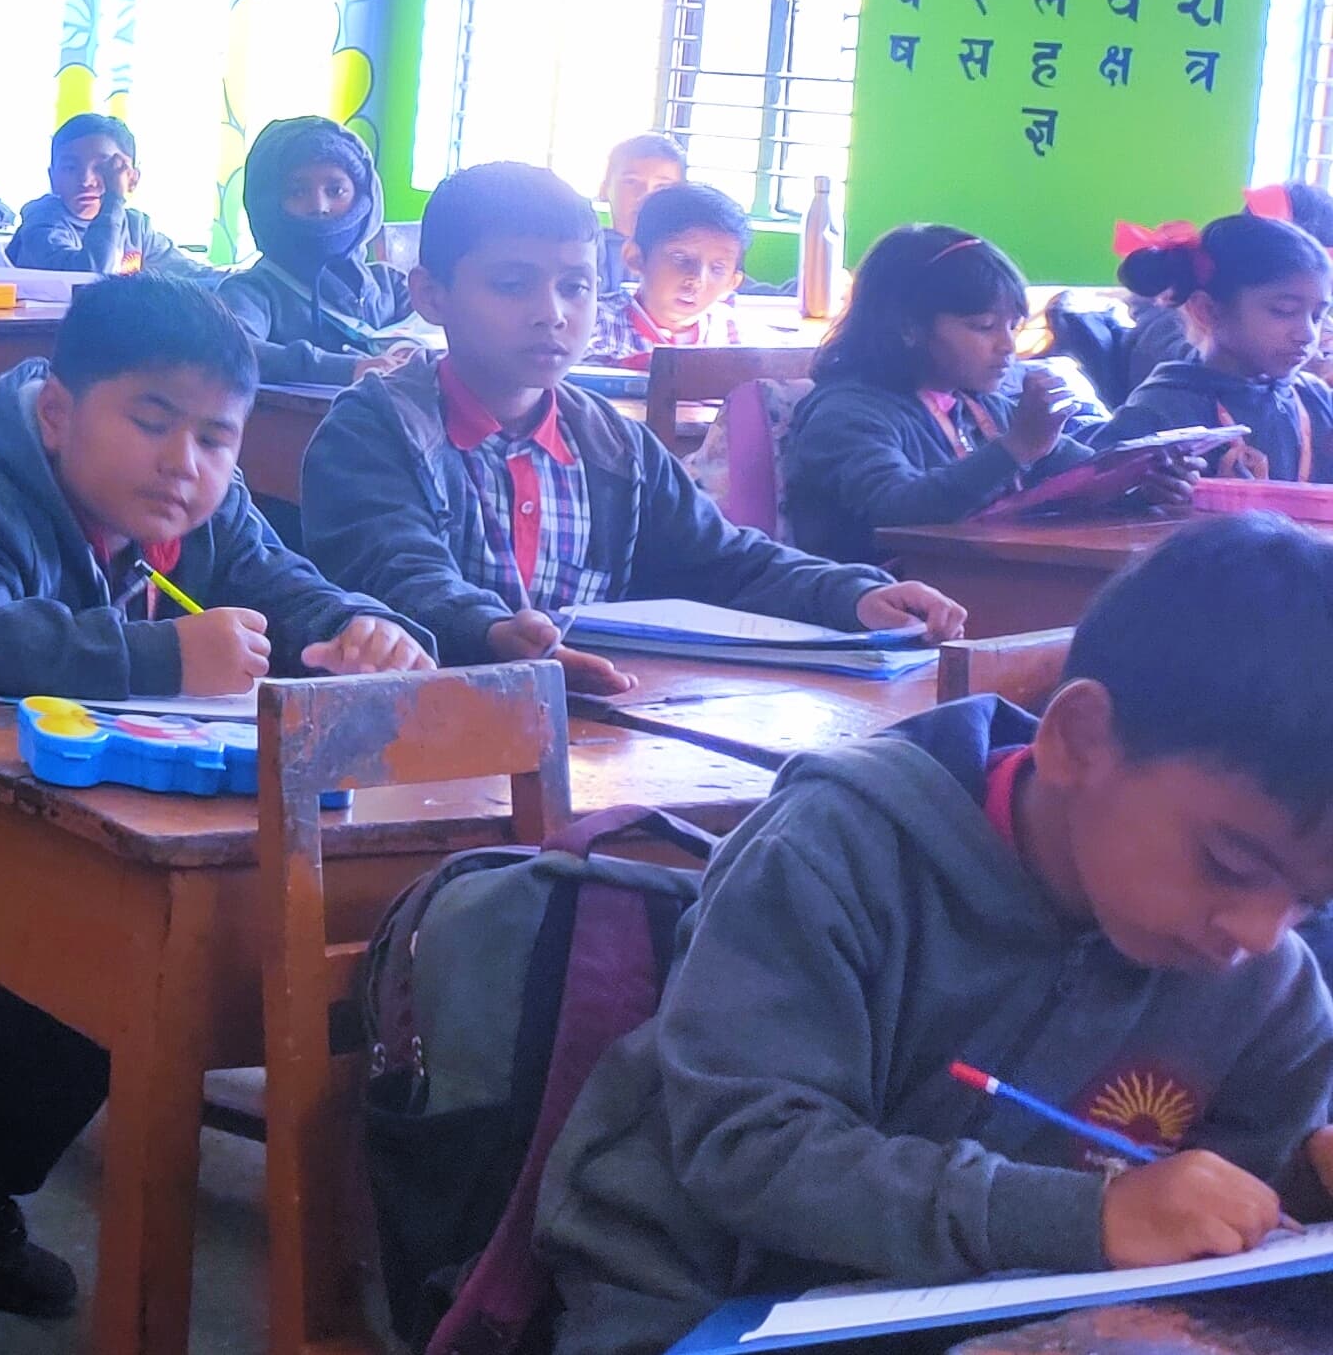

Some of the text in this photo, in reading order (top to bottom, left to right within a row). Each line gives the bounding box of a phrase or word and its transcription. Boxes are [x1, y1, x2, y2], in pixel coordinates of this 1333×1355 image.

[890, 35, 1220, 92] ष स ह क्ष त्र
[1022, 108, 1058, 156] ज्ञ
